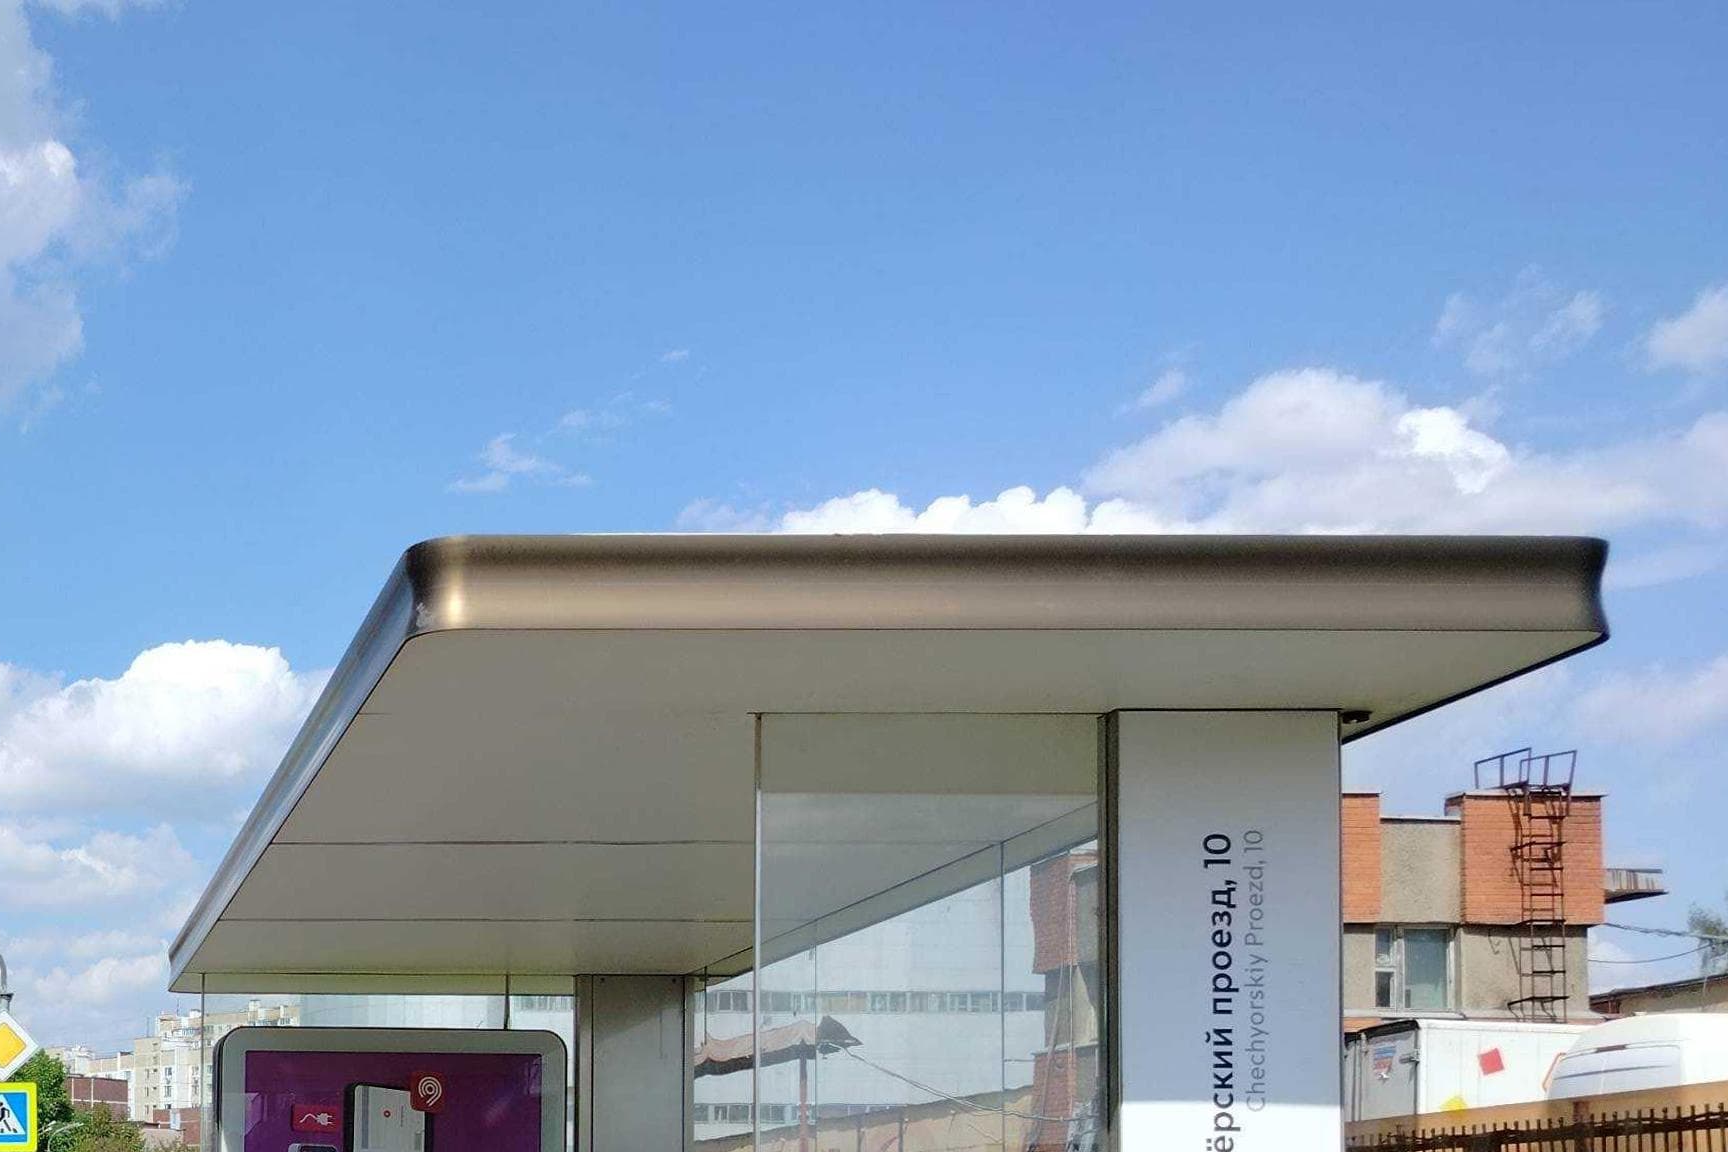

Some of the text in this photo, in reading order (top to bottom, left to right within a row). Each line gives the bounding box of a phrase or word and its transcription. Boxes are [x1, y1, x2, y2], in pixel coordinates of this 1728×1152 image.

[1202, 833, 1231, 869] 10
[1210, 879, 1239, 1015] проезд,
[1243, 829, 1269, 1112] Chechyorskiy Proezd, 10
